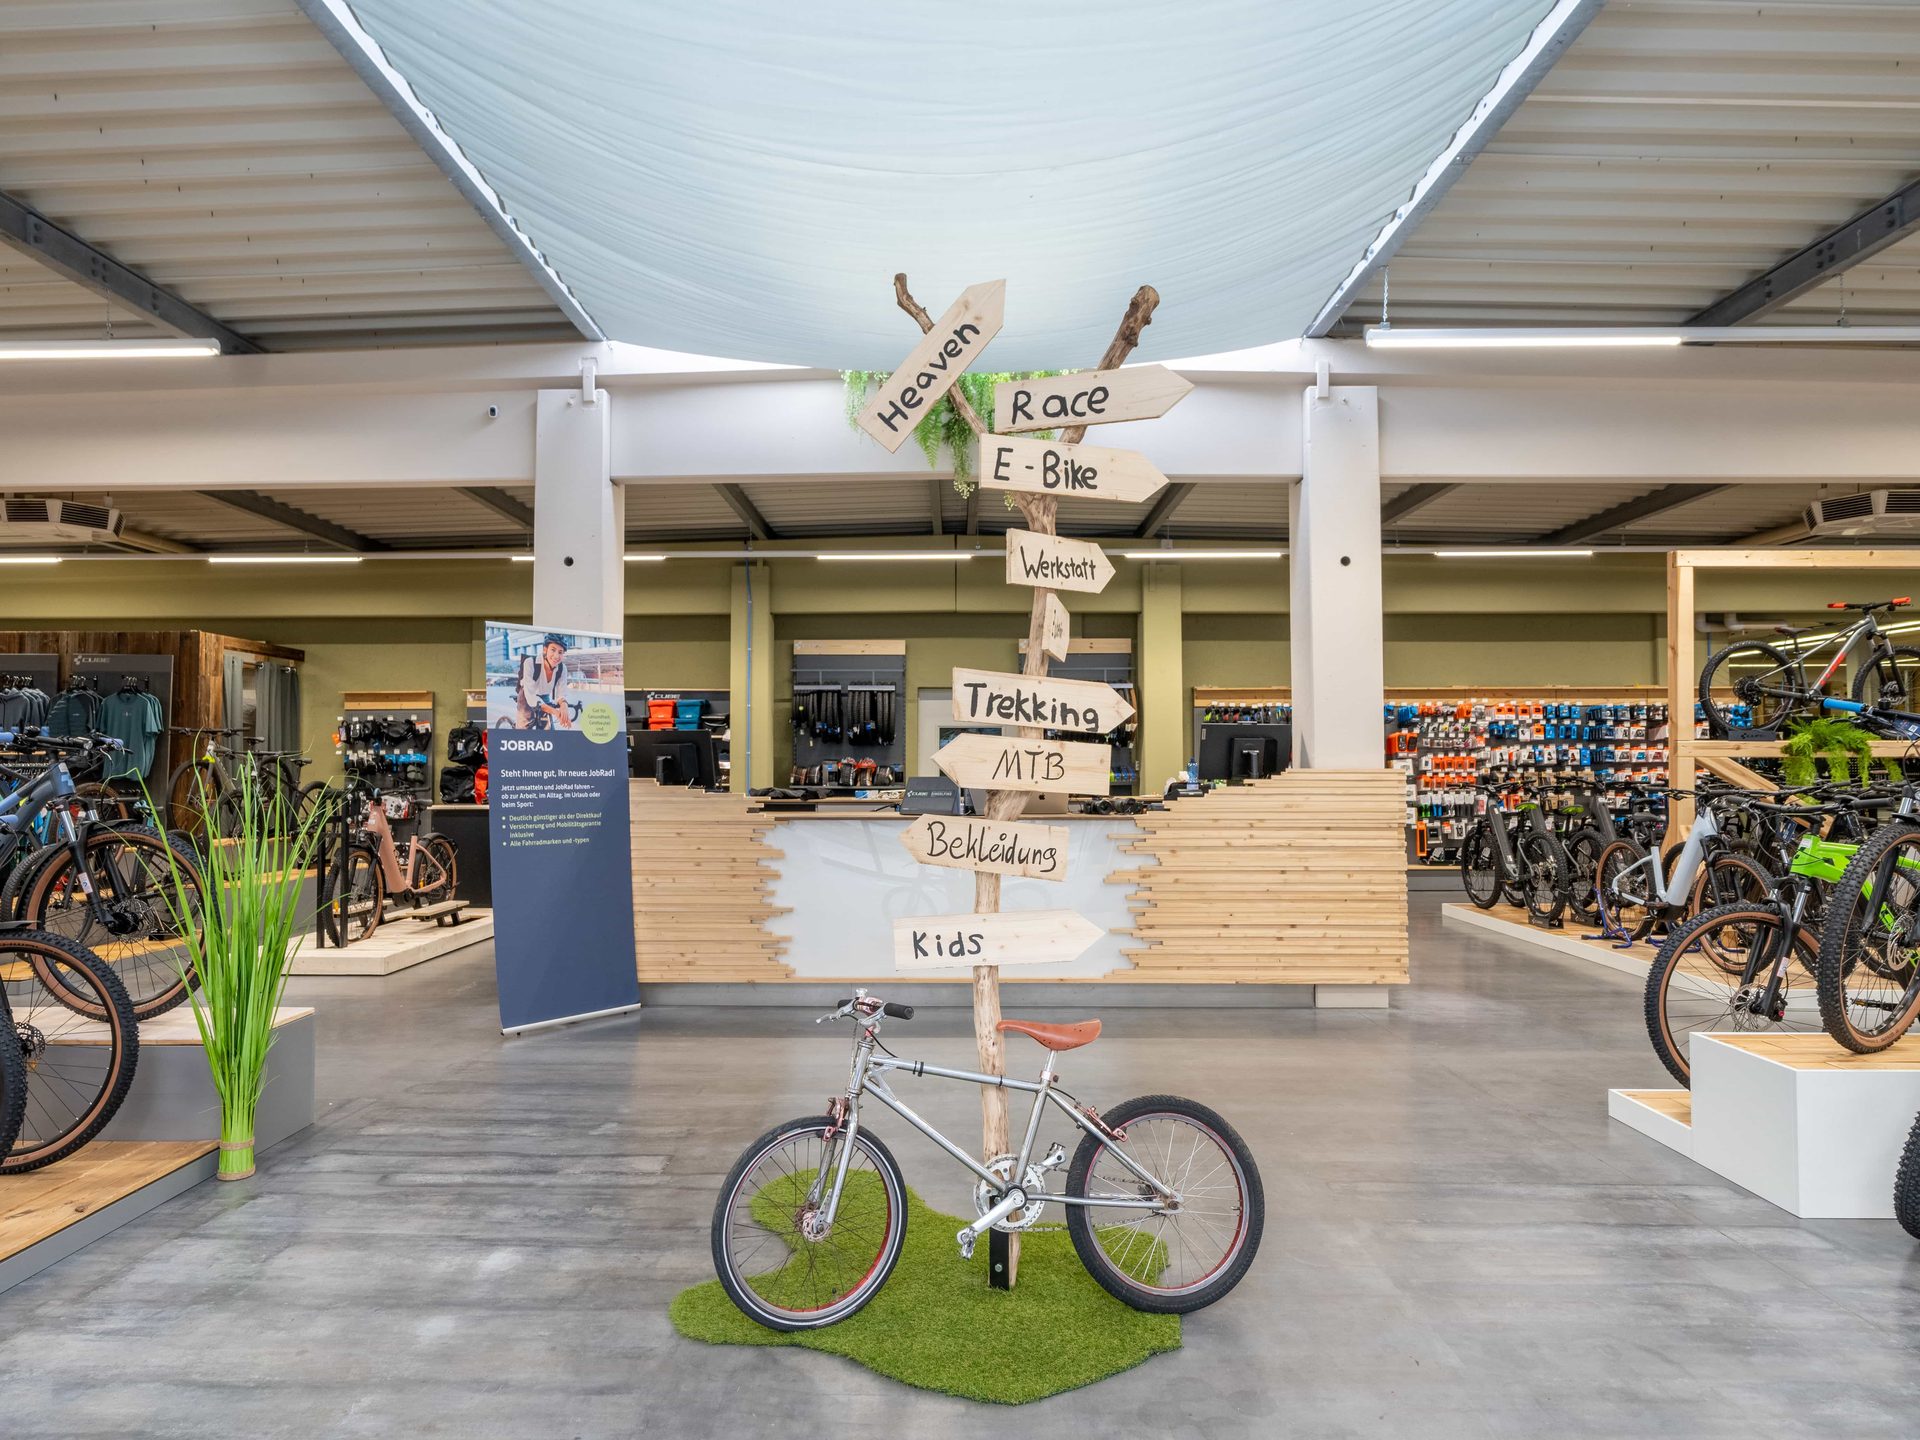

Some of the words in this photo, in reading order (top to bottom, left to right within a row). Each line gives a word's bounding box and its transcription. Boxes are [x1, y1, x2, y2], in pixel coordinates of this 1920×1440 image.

[877, 323, 981, 432] Heaven
[1011, 386, 1109, 425] Race
[1020, 545, 1096, 580] Werkstatt
[964, 682, 1100, 732] Trekking
[500, 740, 553, 752] JOBRAD
[500, 769, 521, 778] Steht
[522, 769, 542, 777] Ihnen
[543, 770, 557, 779] gut,
[558, 769, 567, 777] Ihr
[588, 769, 615, 777] JobRad!
[992, 749, 1065, 781] MTB
[927, 820, 1057, 873] Bekleidung
[912, 930, 984, 960] Kids
